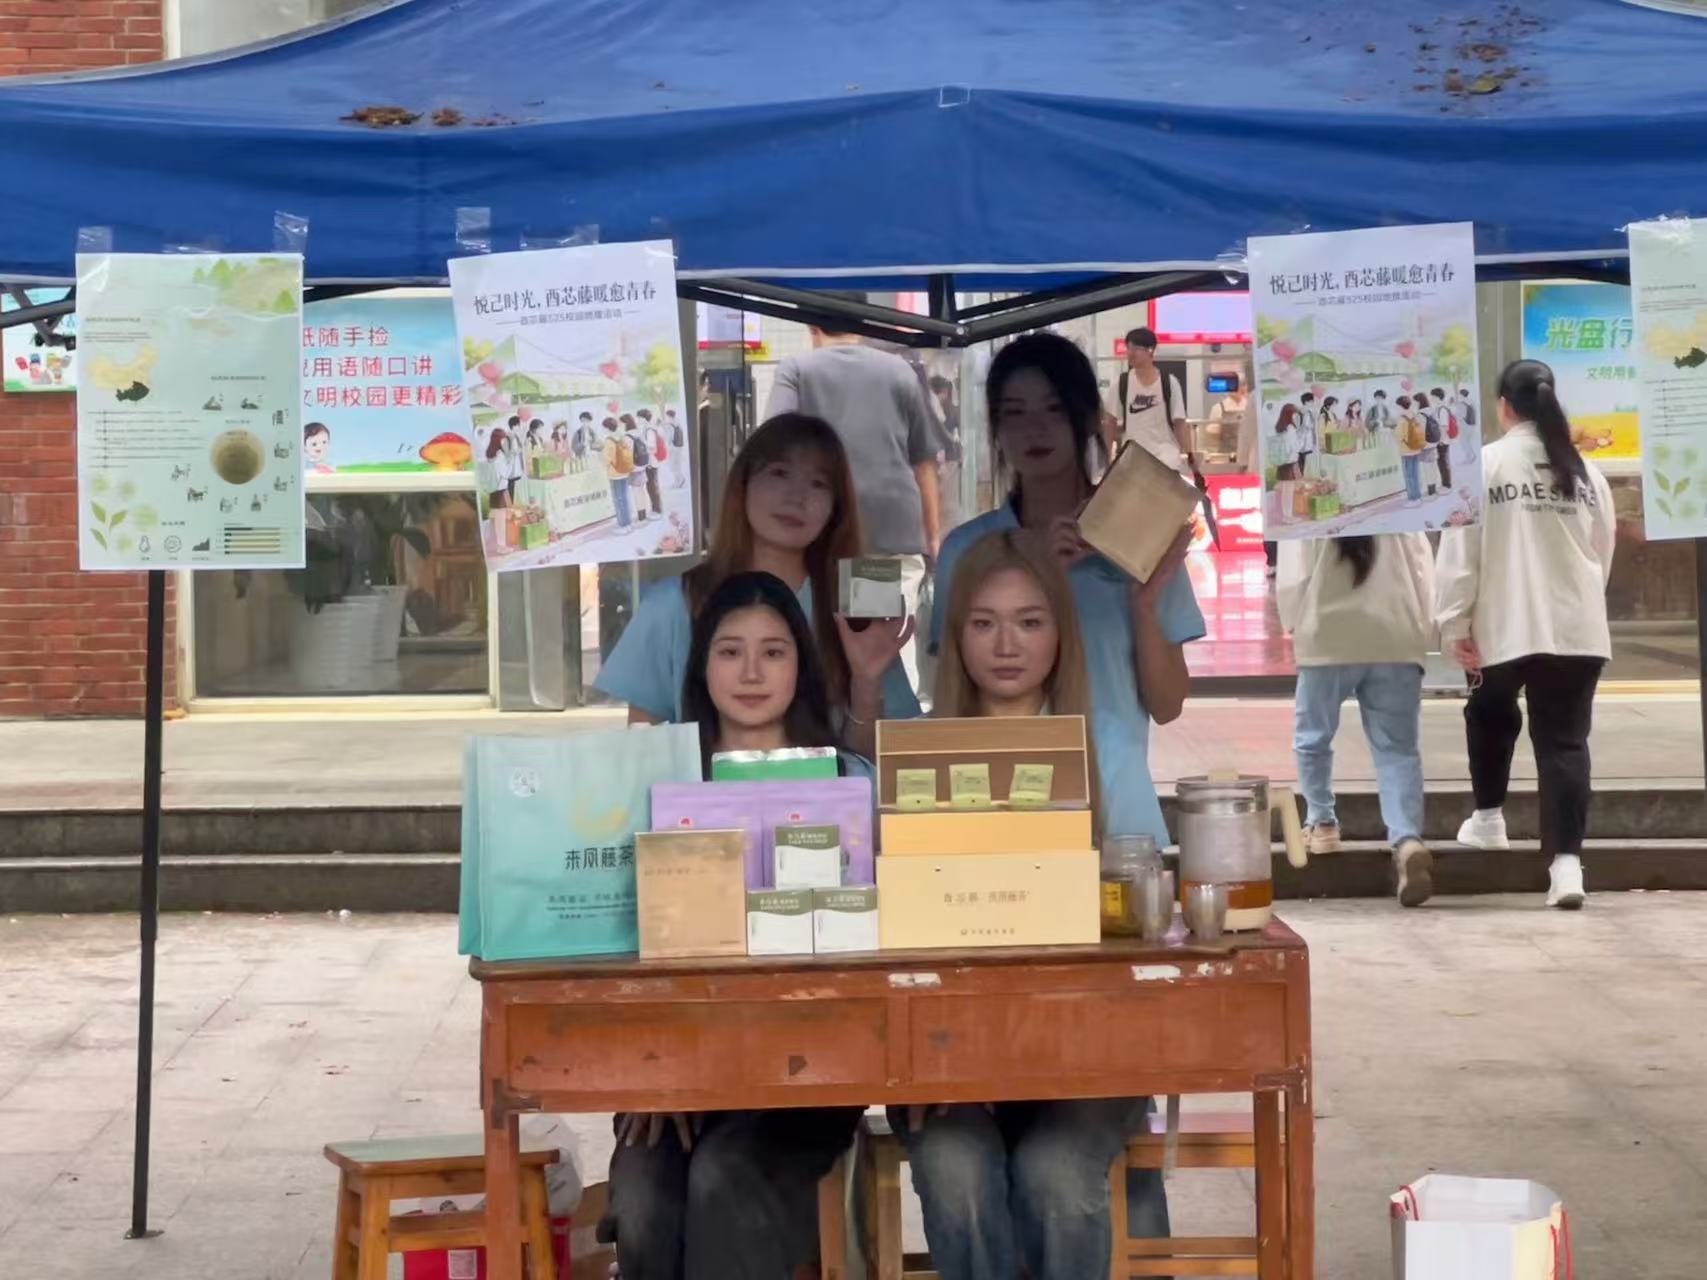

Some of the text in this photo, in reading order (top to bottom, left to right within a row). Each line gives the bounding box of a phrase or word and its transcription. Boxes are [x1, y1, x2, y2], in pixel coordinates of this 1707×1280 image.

[303, 354, 433, 377] 用语随口讲
